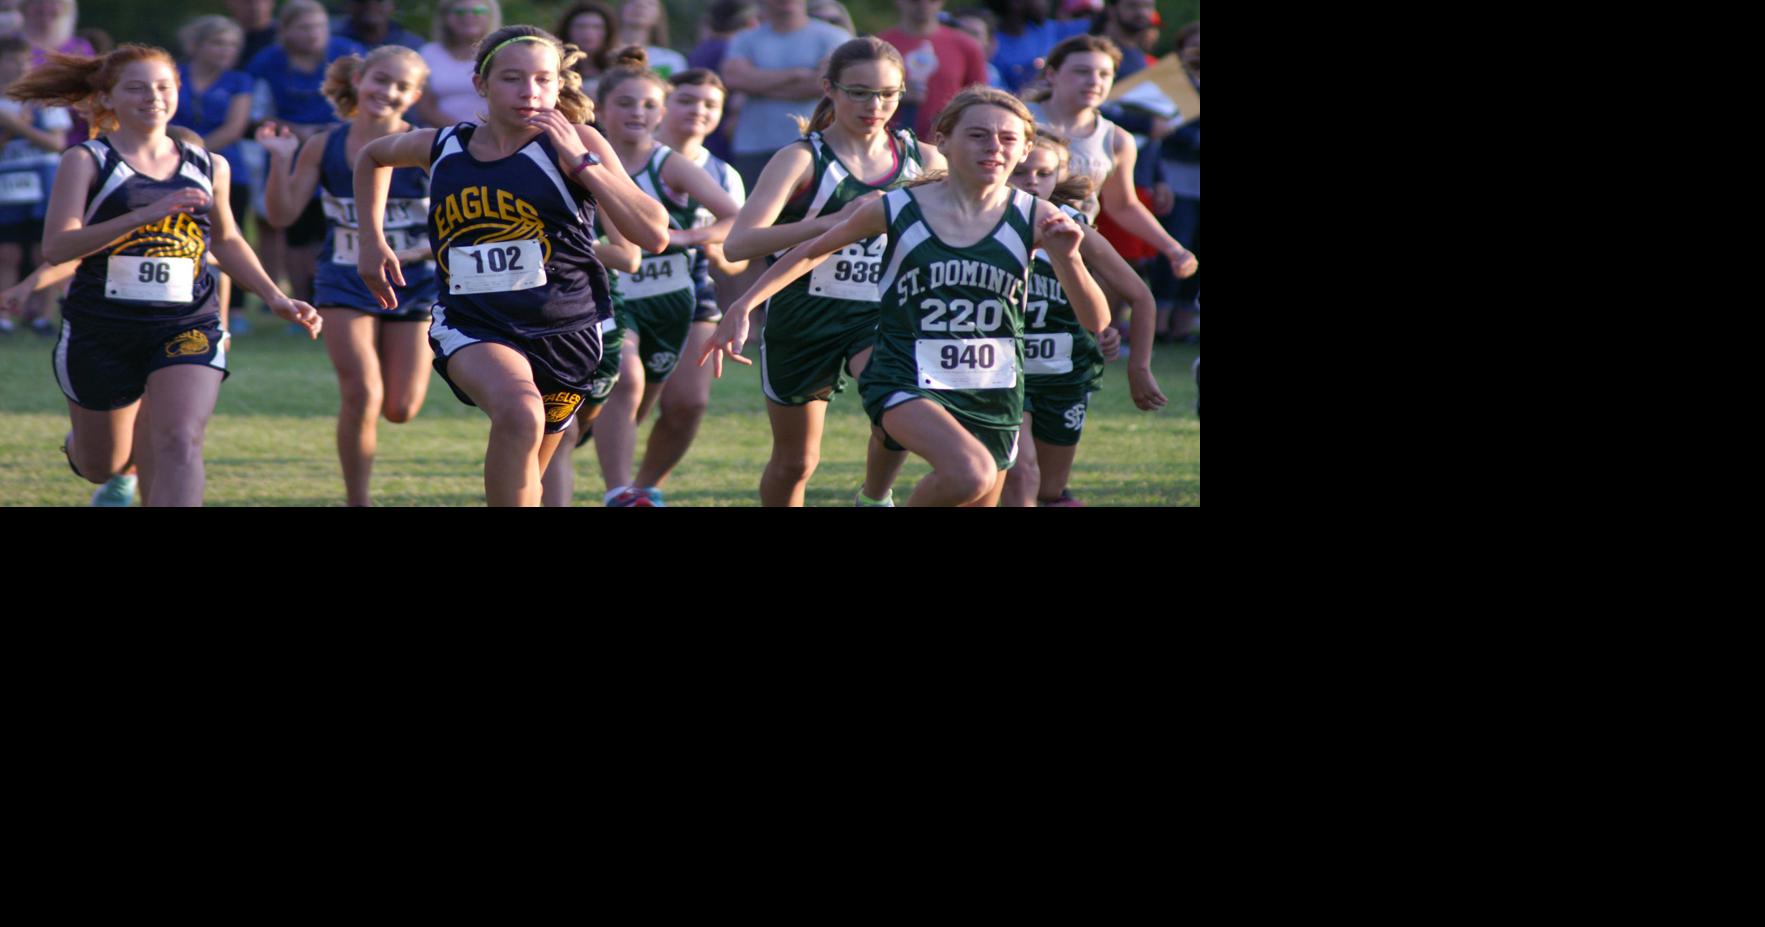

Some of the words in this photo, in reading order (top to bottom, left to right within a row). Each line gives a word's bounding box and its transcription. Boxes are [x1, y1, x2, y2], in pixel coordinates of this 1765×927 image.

[434, 185, 545, 240] EAGLES
[138, 261, 170, 284] 96
[469, 246, 524, 274] 102
[834, 260, 881, 285] 938
[898, 268, 925, 306] ST.
[929, 259, 1024, 305] DOMINIC
[920, 298, 1004, 332] 220
[940, 344, 995, 370] 940
[1024, 338, 1056, 360] 50
